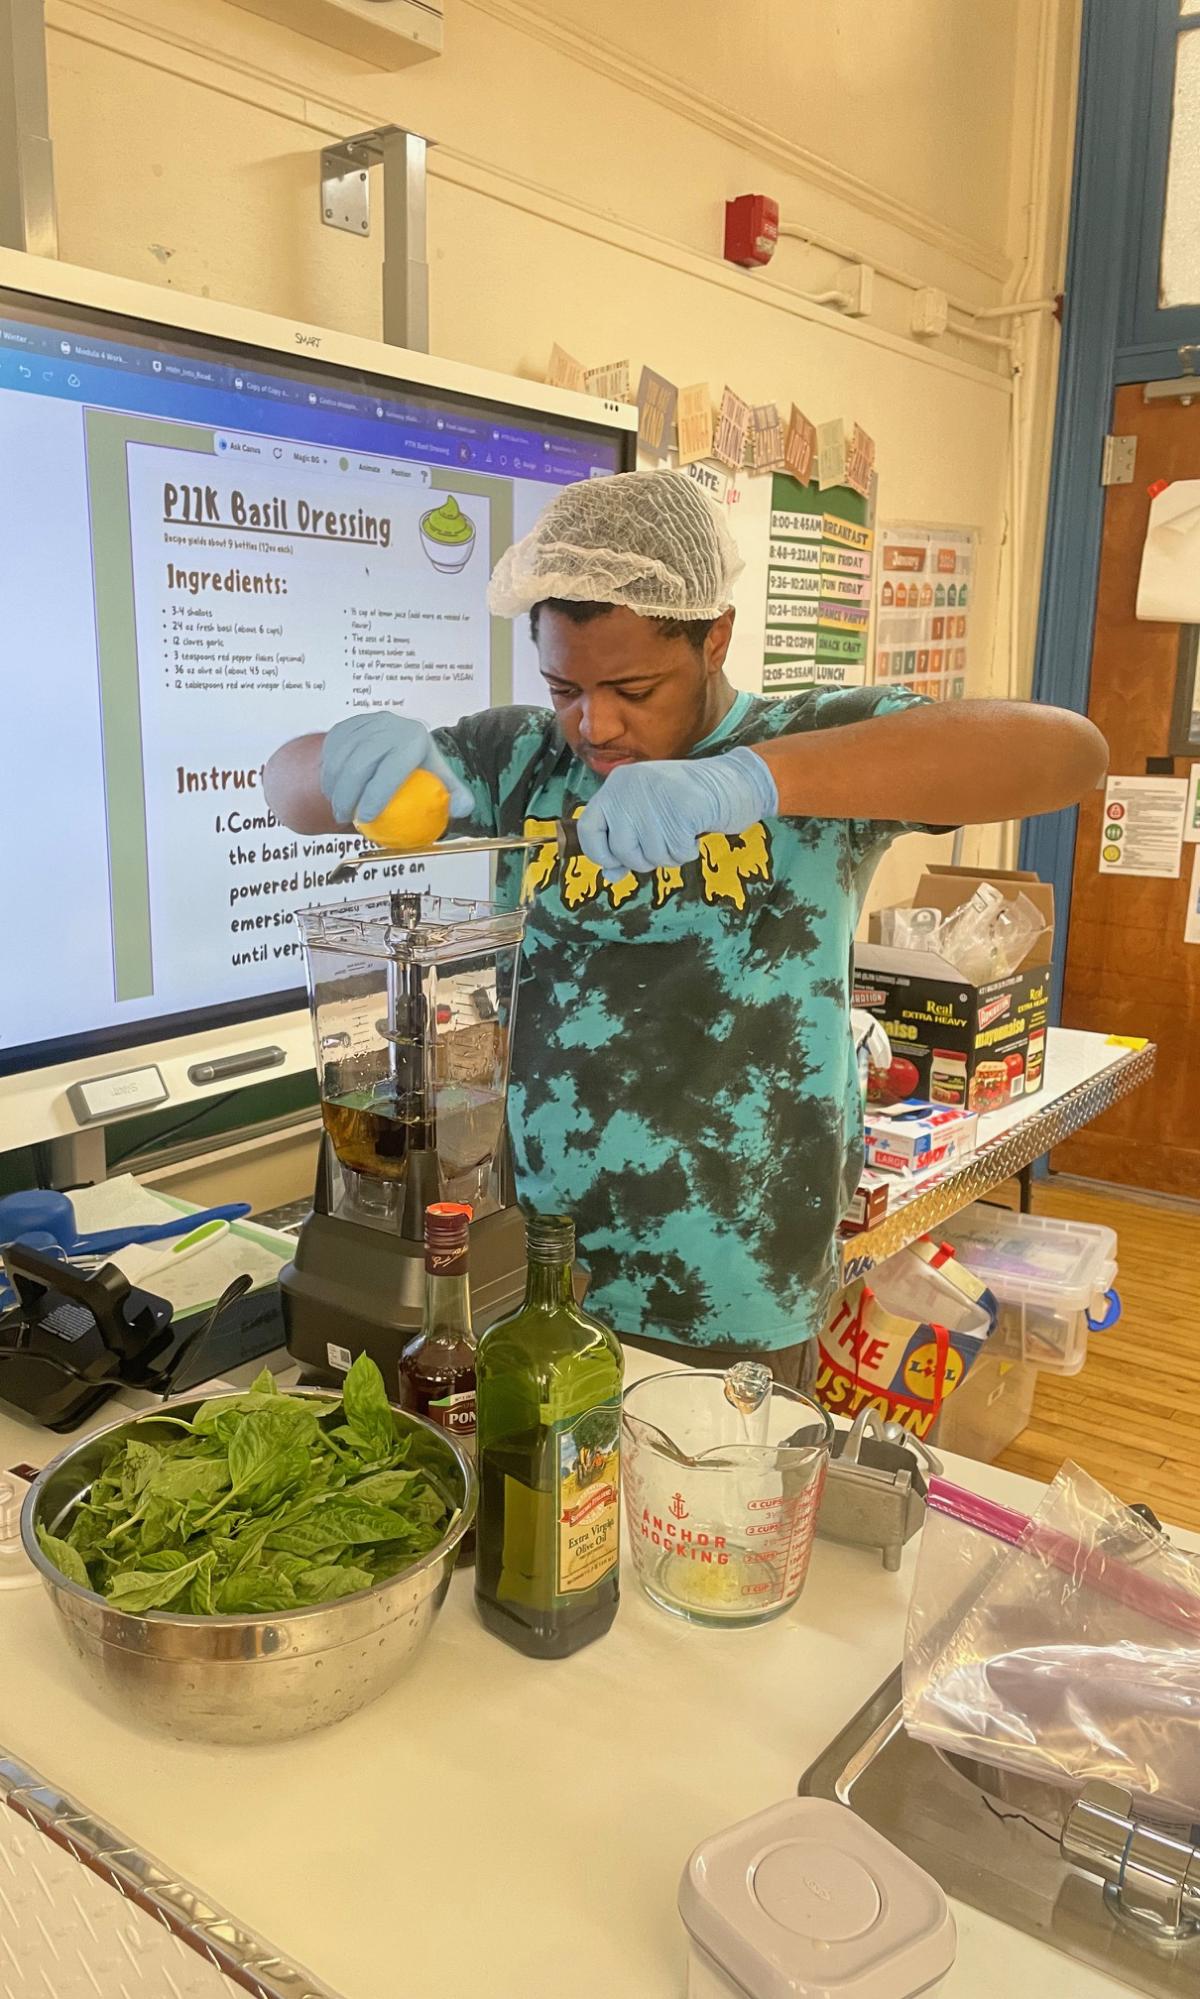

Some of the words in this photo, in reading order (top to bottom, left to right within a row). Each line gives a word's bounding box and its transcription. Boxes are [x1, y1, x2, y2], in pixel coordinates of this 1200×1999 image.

[231, 490, 287, 529] Basil
[298, 499, 391, 548] Dressing
[164, 532, 186, 546] Recipe
[188, 536, 206, 547] yields
[208, 538, 226, 547] about
[234, 540, 257, 551] bottles
[823, 519, 868, 545] BREAKFAST
[822, 551, 836, 564] FUN
[838, 554, 864, 569] FRIDAY
[166, 563, 288, 595] Ingredients:
[822, 579, 836, 591] FUN
[838, 581, 864, 595] FRIDAY
[172, 620, 183, 631] 24
[196, 623, 214, 632] fresh
[217, 623, 232, 633] basil
[234, 622, 257, 634] (about
[183, 637, 204, 647] cloves
[206, 638, 224, 649] garlic
[182, 653, 216, 662] teaspoons
[217, 653, 229, 661] red
[232, 654, 252, 664] pepper
[816, 667, 845, 681] LUNCH
[226, 681, 238, 689] red
[257, 682, 280, 691] vinegar
[177, 763, 265, 794] Instruct
[228, 809, 284, 833] Comb
[229, 846, 256, 866] the
[262, 841, 298, 863] basil
[230, 872, 299, 906] powered
[363, 867, 378, 880] or
[383, 862, 405, 878] use
[409, 861, 425, 874] an
[230, 908, 295, 932] emersio
[232, 943, 268, 966] until
[1030, 984, 1043, 1000] Real
[926, 1000, 953, 1016] Real
[902, 1010, 933, 1022] EXTRA
[935, 1015, 967, 1028] HEAVY
[815, 1364, 934, 1438] USTAIN
[760, 1499, 783, 1508] CUPS
[642, 1508, 726, 1549] ANCHOR
[757, 1524, 779, 1533] CUPS
[568, 1533, 590, 1549] Extra
[575, 1543, 594, 1557] Olive
[595, 1531, 607, 1546] Oil
[641, 1522, 729, 1565] HOCKING
